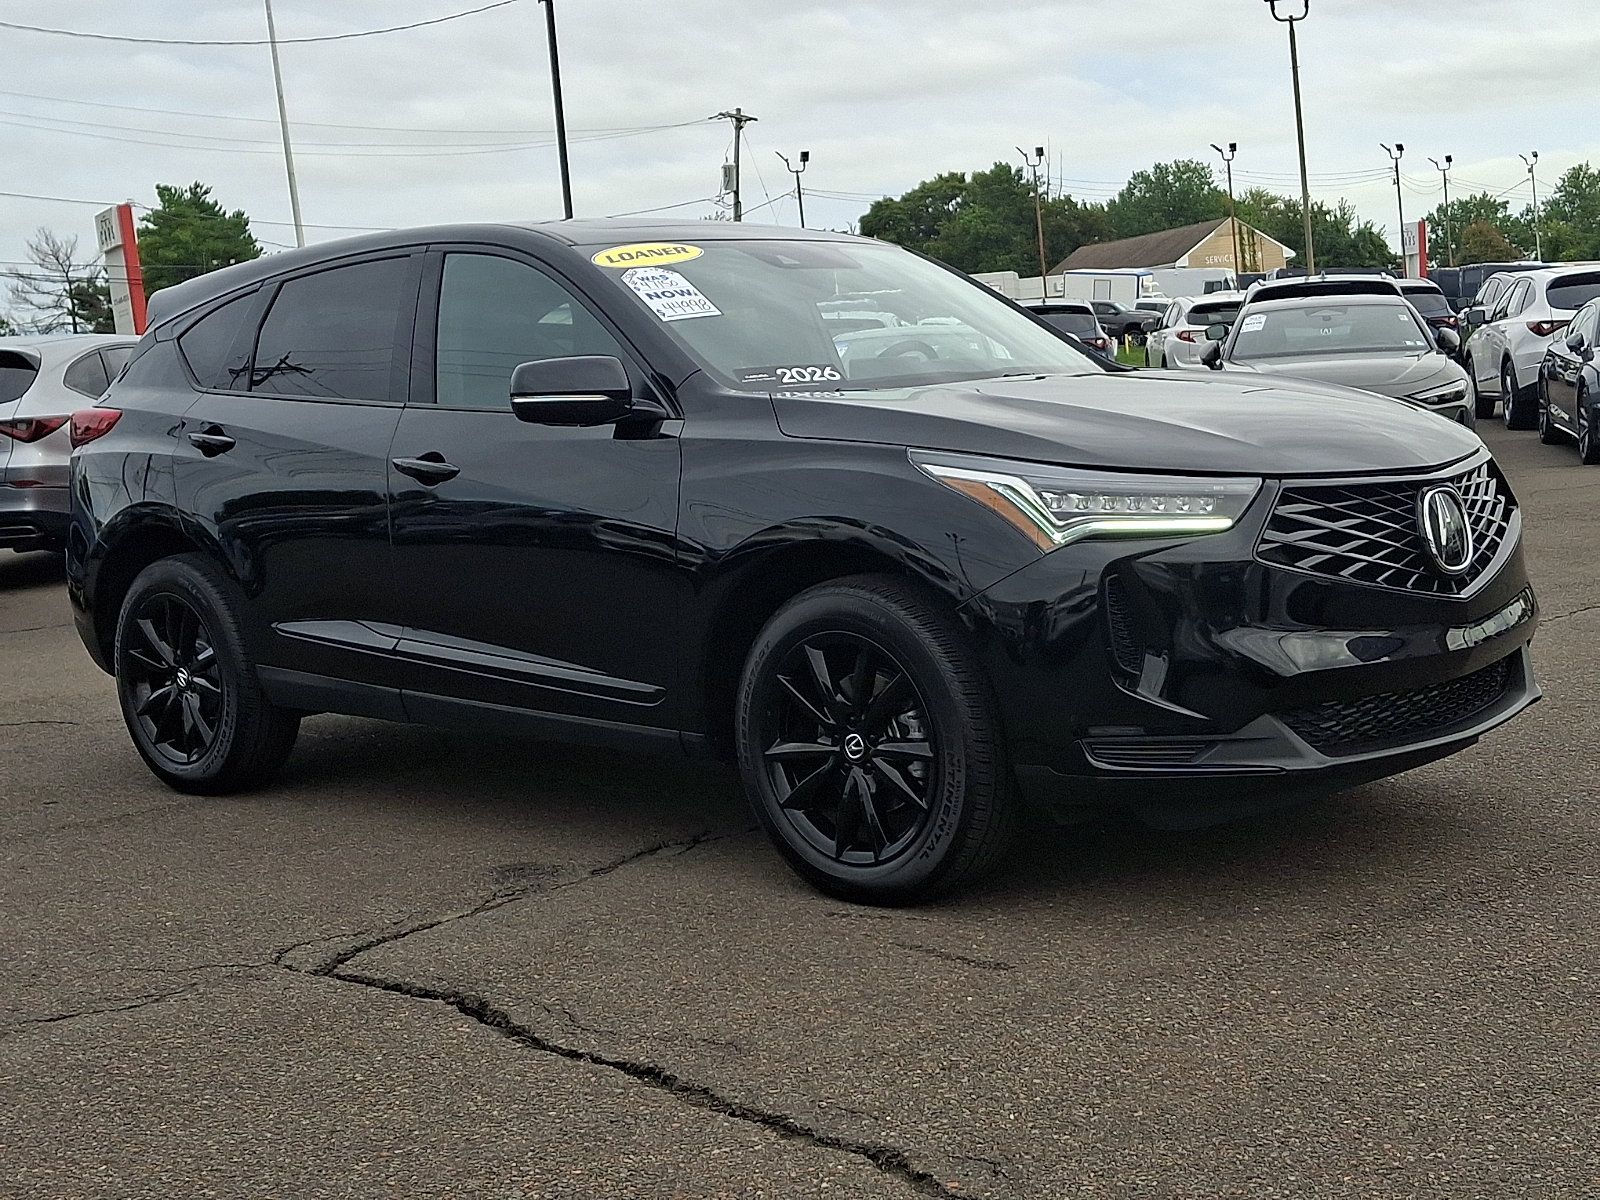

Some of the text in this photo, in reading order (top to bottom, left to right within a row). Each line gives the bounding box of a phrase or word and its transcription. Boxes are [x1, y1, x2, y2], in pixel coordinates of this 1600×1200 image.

[605, 247, 691, 264] LOANER
[1205, 254, 1233, 265] SERVICE
[636, 274, 669, 282] WAS
[775, 366, 841, 383] 2026
